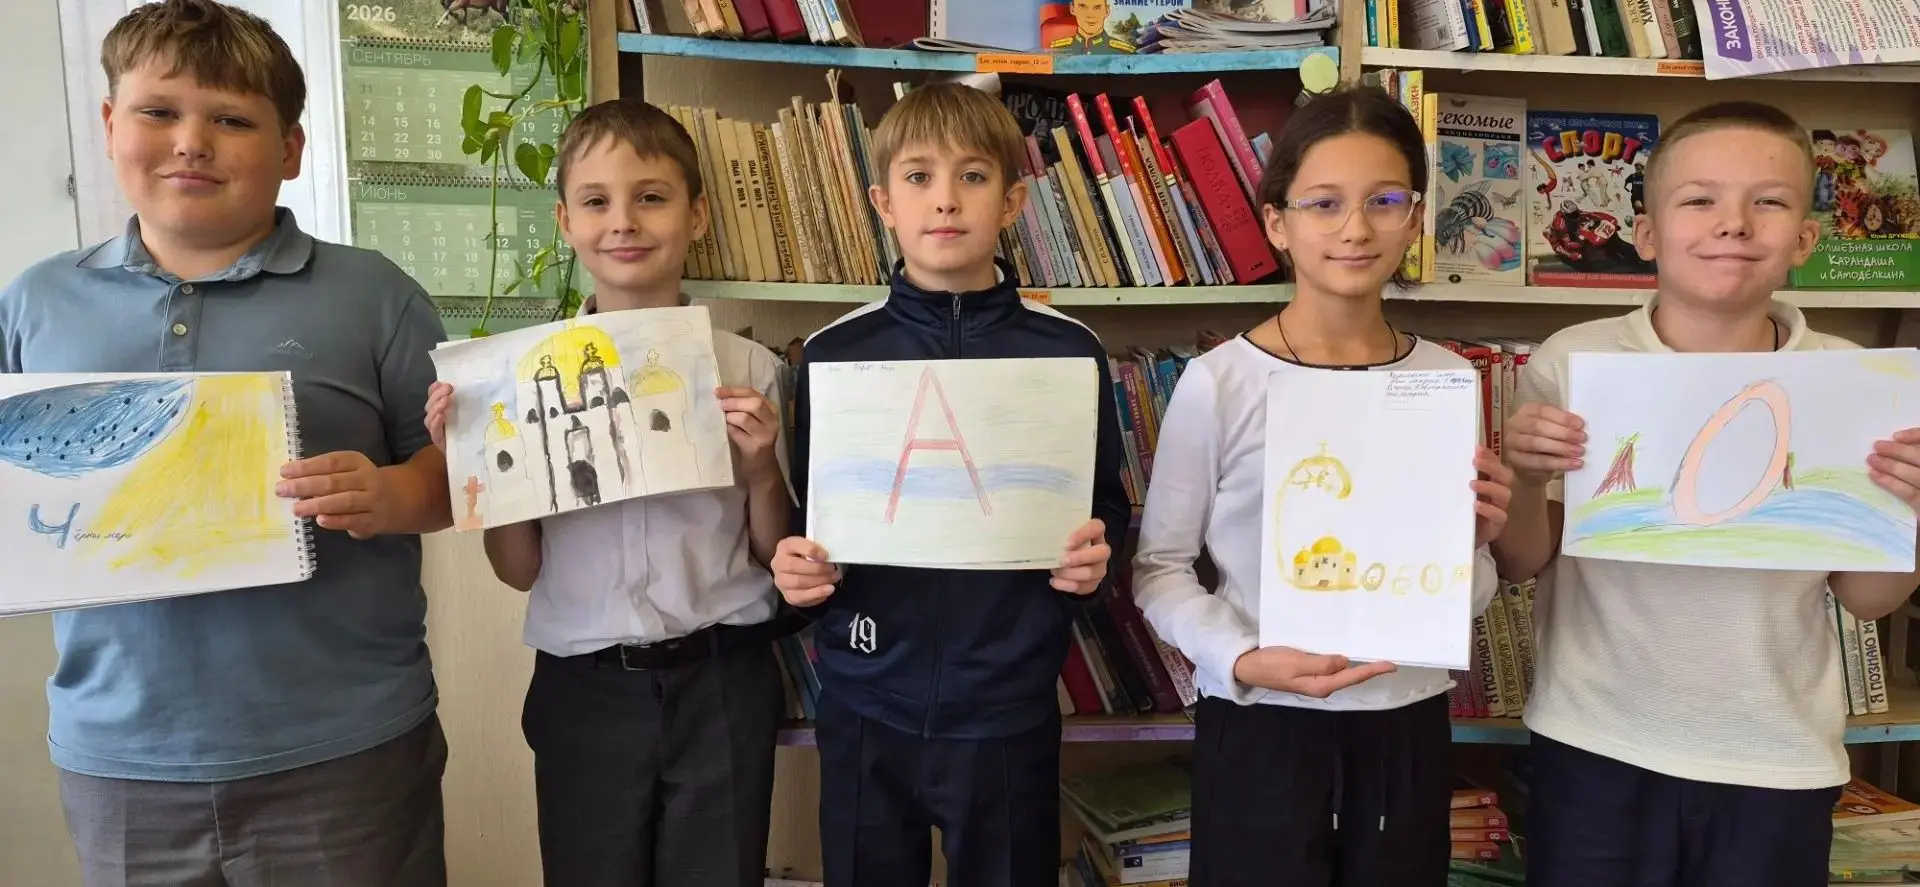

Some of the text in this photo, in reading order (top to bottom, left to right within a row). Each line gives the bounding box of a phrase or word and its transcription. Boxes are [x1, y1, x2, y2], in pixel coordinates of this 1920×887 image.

[347, 4, 396, 22] 2026
[1718, 0, 1741, 50] ЗАКОН
[353, 49, 431, 66] СЕНТЯБРЬ
[360, 84, 435, 97] 31 1 2
[363, 100, 435, 113] 7 8 9
[361, 116, 440, 129] 14 15 16
[522, 122, 535, 132] 19
[361, 131, 440, 144] 21 22 23
[362, 147, 441, 160] 28 29 30
[1542, 130, 1643, 165] СПОРТ
[361, 186, 407, 200] ИЮНЬ
[370, 220, 376, 230] 1
[402, 220, 410, 231] 2
[434, 221, 442, 231] 3
[466, 222, 474, 232] 4
[529, 224, 536, 234] 6
[371, 235, 378, 246] 8
[403, 235, 410, 246] 9
[432, 237, 446, 247] 10
[465, 238, 476, 247] 11
[496, 239, 509, 248] 12
[527, 239, 540, 248] 13
[402, 252, 415, 261] 16
[432, 252, 447, 262] 17
[465, 253, 478, 262] 18
[432, 267, 447, 276] 24
[465, 268, 478, 278] 25
[496, 268, 510, 278] 26
[468, 283, 475, 292] 2
[885, 365, 992, 524] А
[1672, 376, 1791, 527] О
[848, 613, 877, 654] 19
[1473, 615, 1499, 705] Я ПОЗНАЮ МИ
[1865, 636, 1883, 691] ПОЗНАЮ
[1870, 693, 1884, 703] Я
